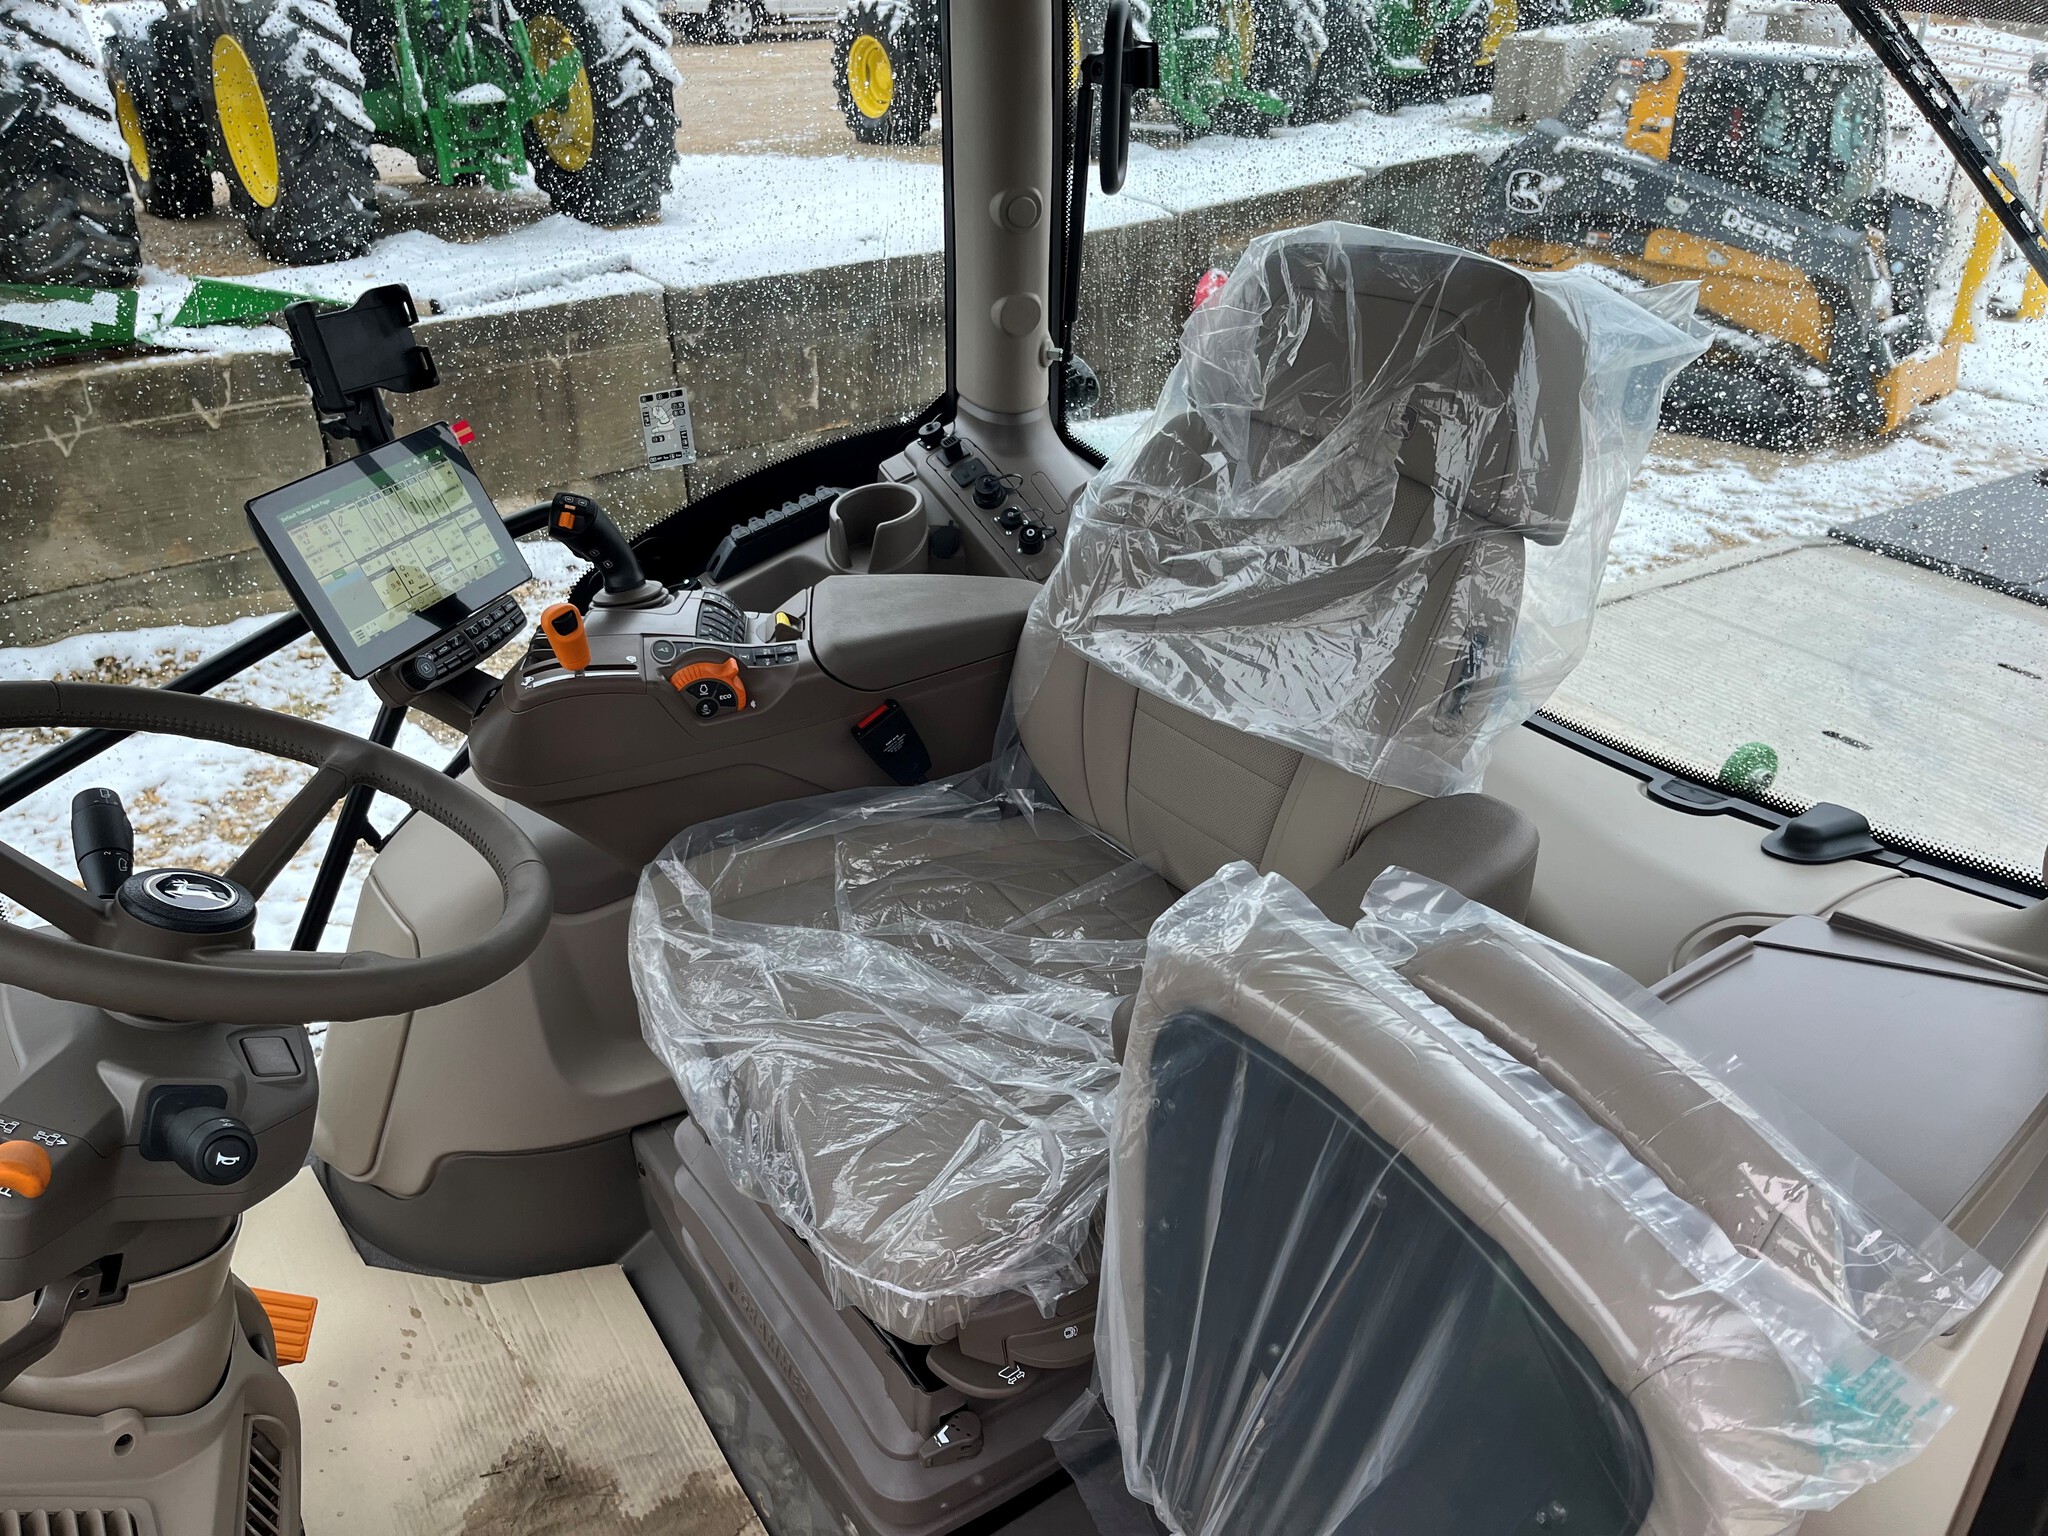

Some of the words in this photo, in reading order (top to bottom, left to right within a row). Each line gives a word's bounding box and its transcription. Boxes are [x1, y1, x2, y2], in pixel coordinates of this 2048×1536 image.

[1721, 206, 1798, 253] DEERE
[280, 511, 298, 524] Default
[296, 506, 312, 516] Tractor
[311, 501, 320, 510] Run
[319, 498, 331, 507] Page
[719, 693, 732, 701] ECO
